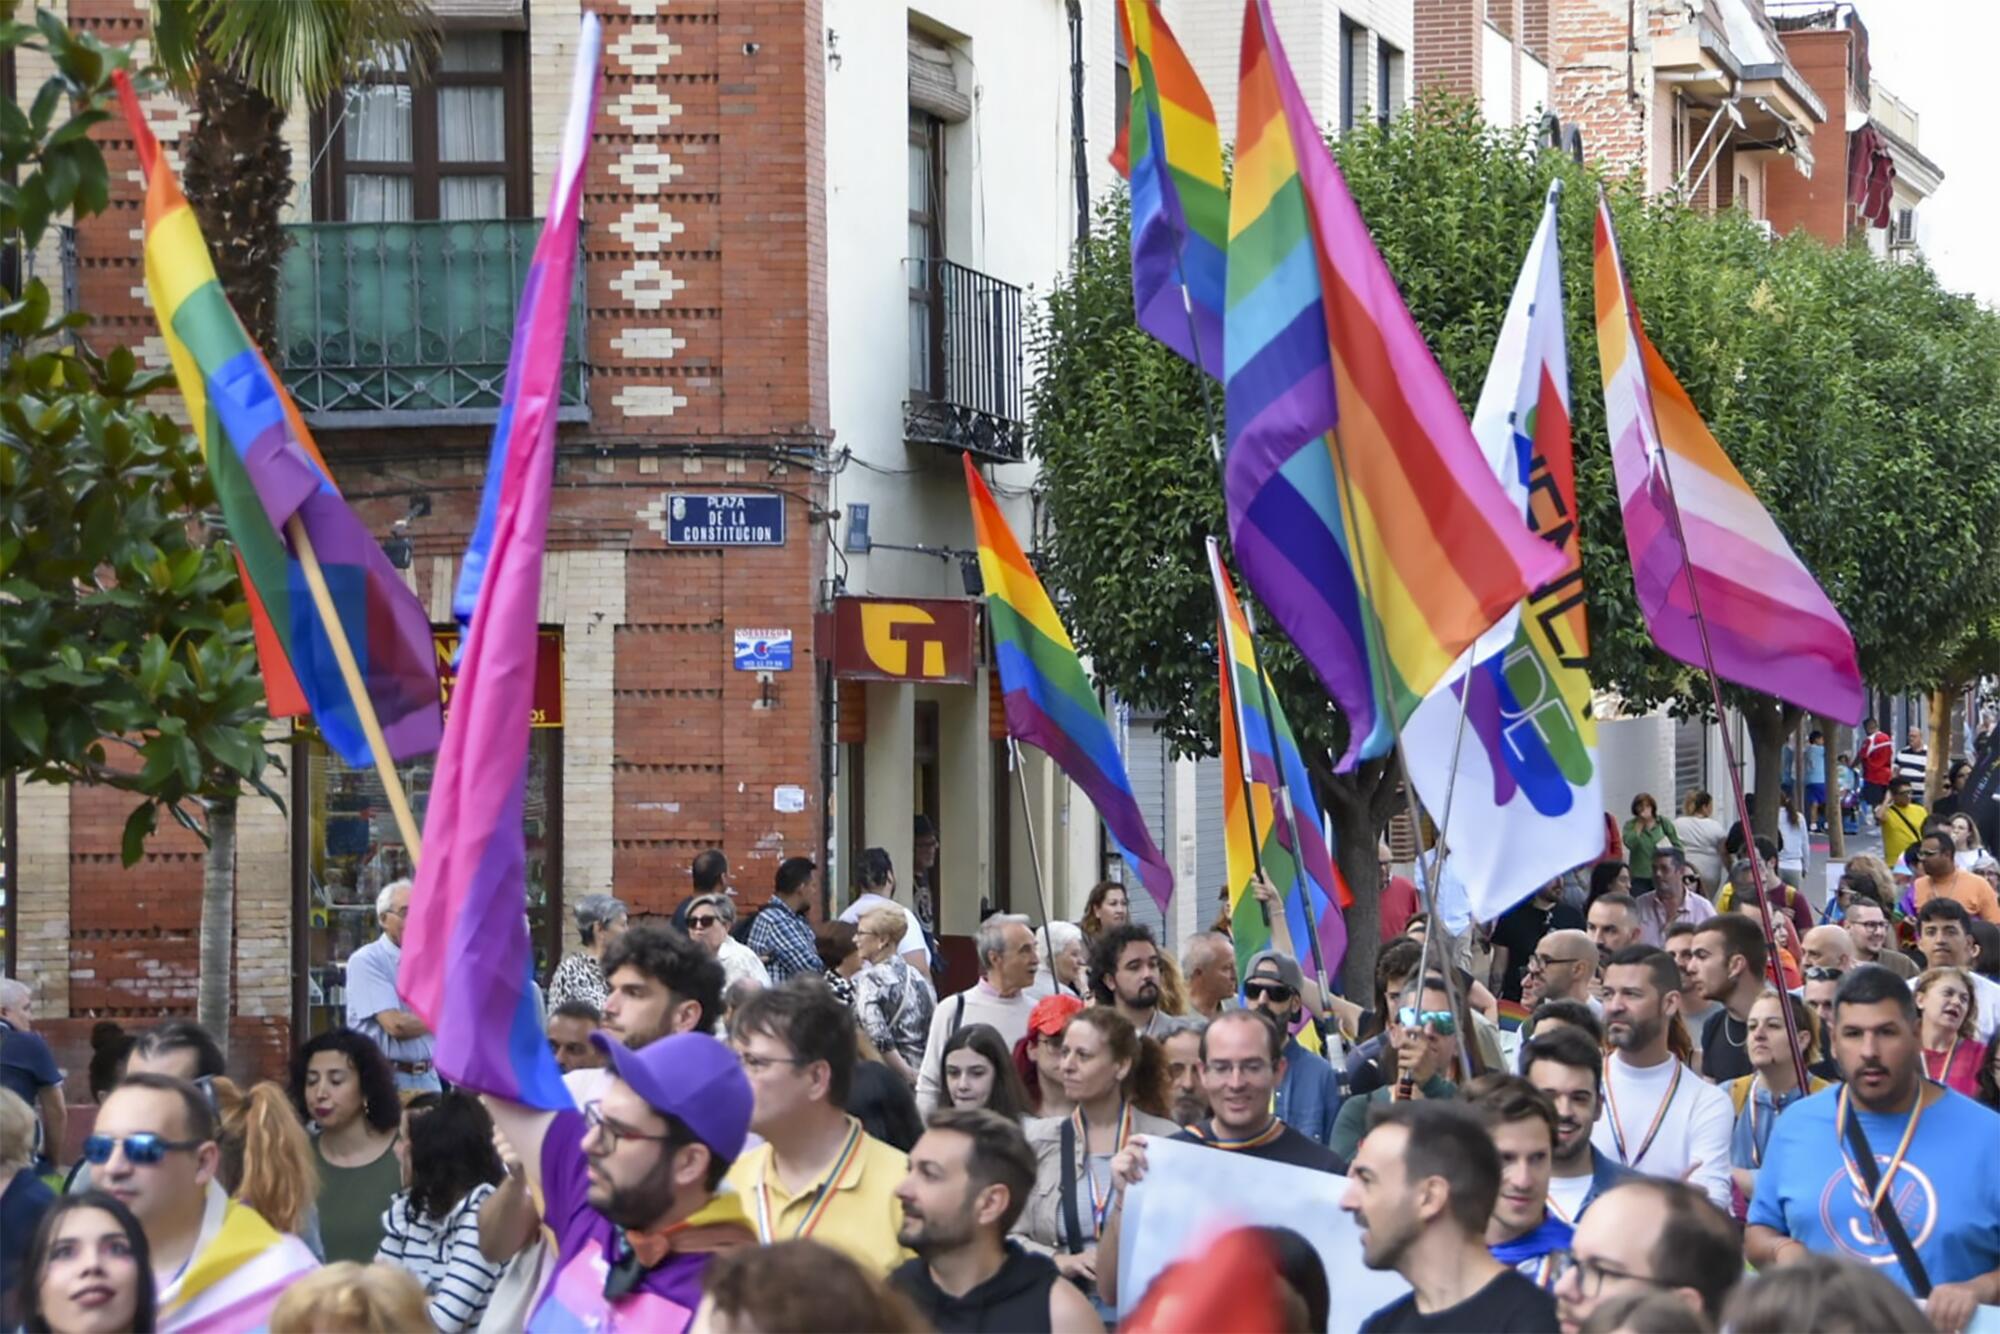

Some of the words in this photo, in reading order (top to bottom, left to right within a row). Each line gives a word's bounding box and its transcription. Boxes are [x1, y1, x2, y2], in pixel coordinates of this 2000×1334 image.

[707, 496, 746, 509] PLAZA
[709, 510, 723, 526] DE
[731, 510, 746, 526] LA
[683, 526, 772, 541] CONSTITUCION
